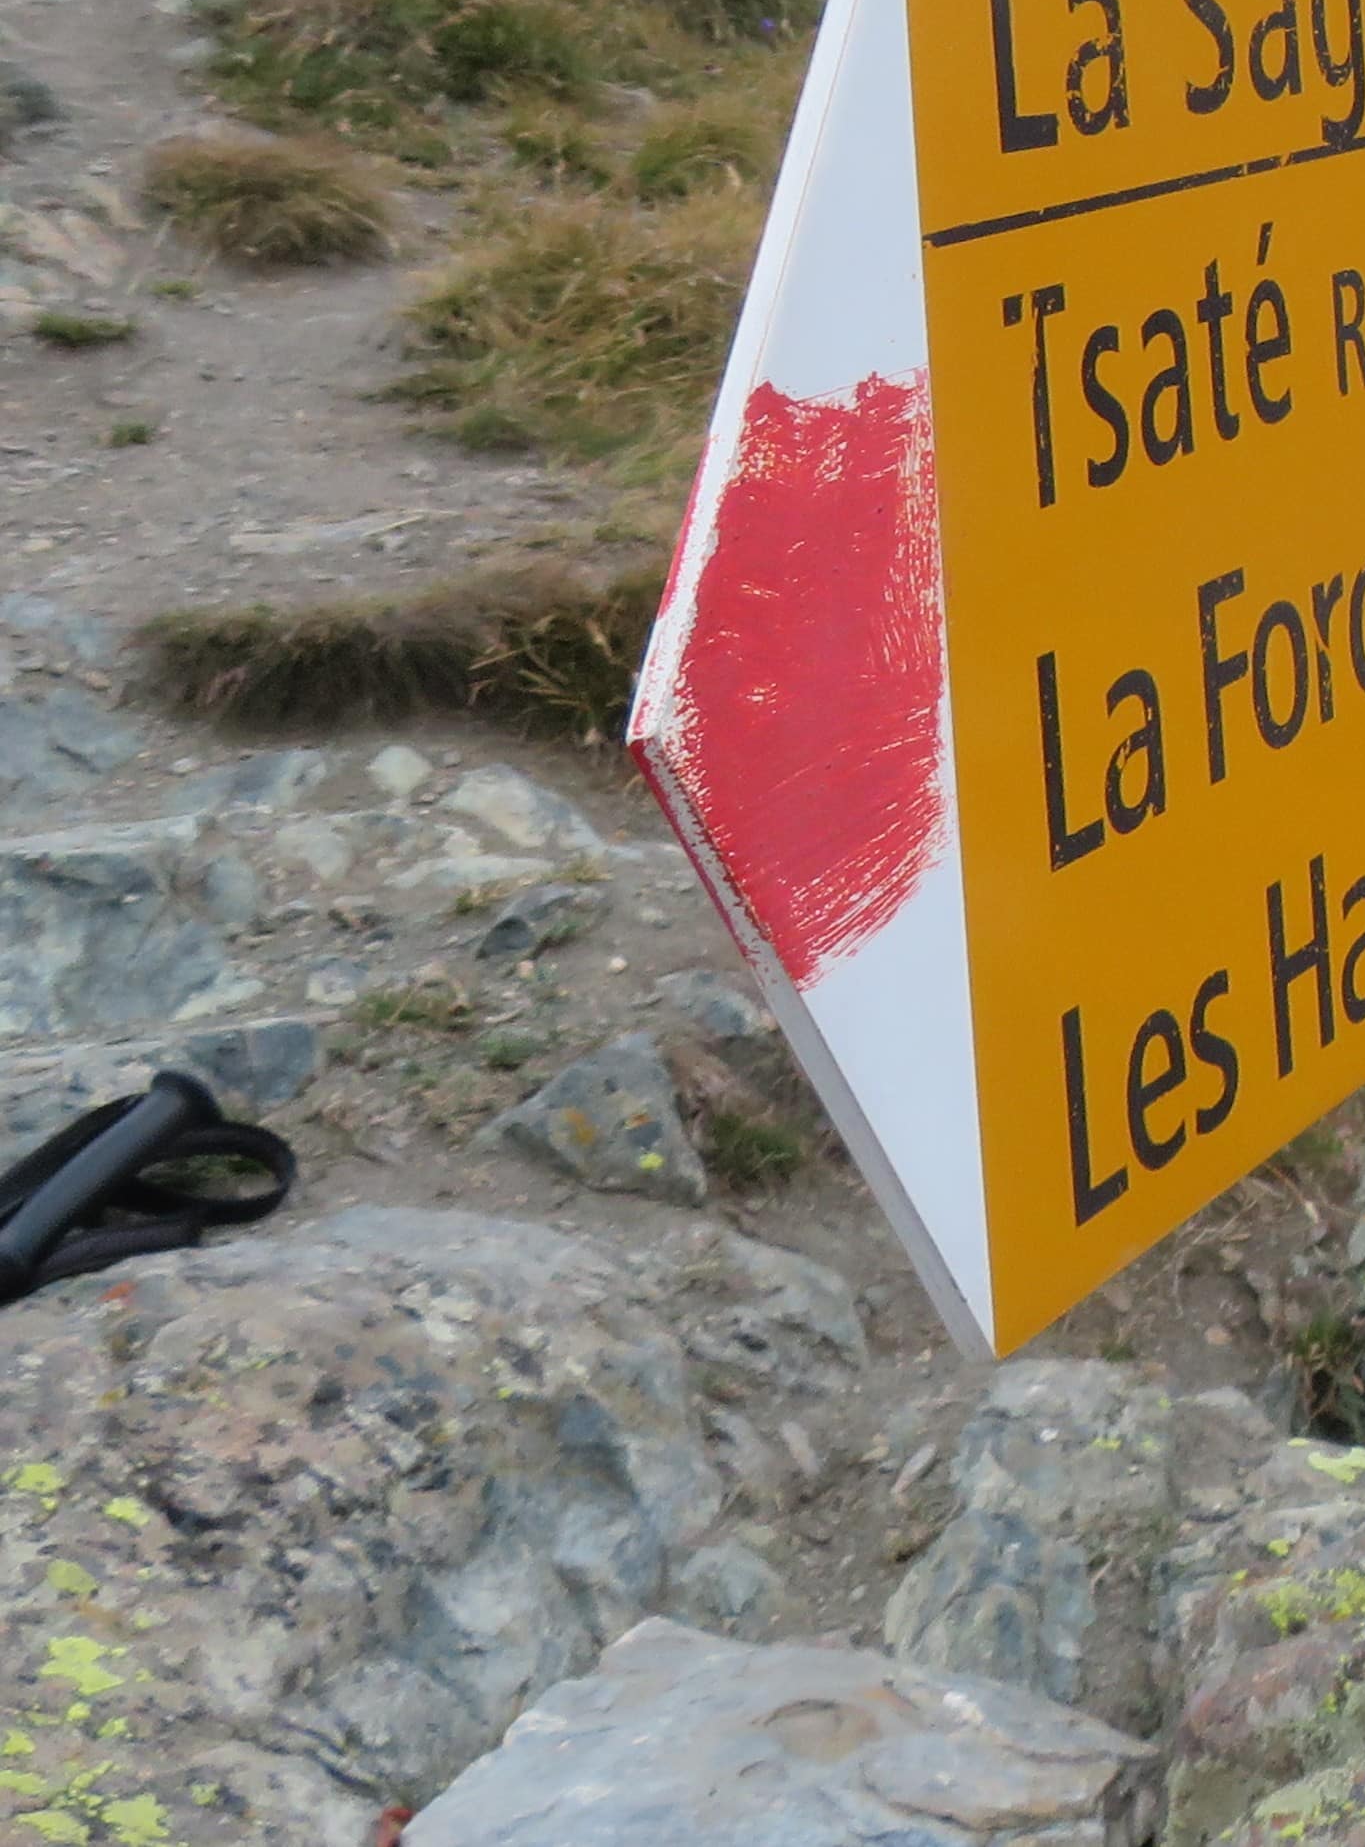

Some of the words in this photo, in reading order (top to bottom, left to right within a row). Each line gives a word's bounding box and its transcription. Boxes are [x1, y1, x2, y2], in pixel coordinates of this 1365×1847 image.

[1001, 222, 1293, 510] Tsaté
[1038, 652, 1165, 869] La
[1061, 968, 1241, 1229] Les
